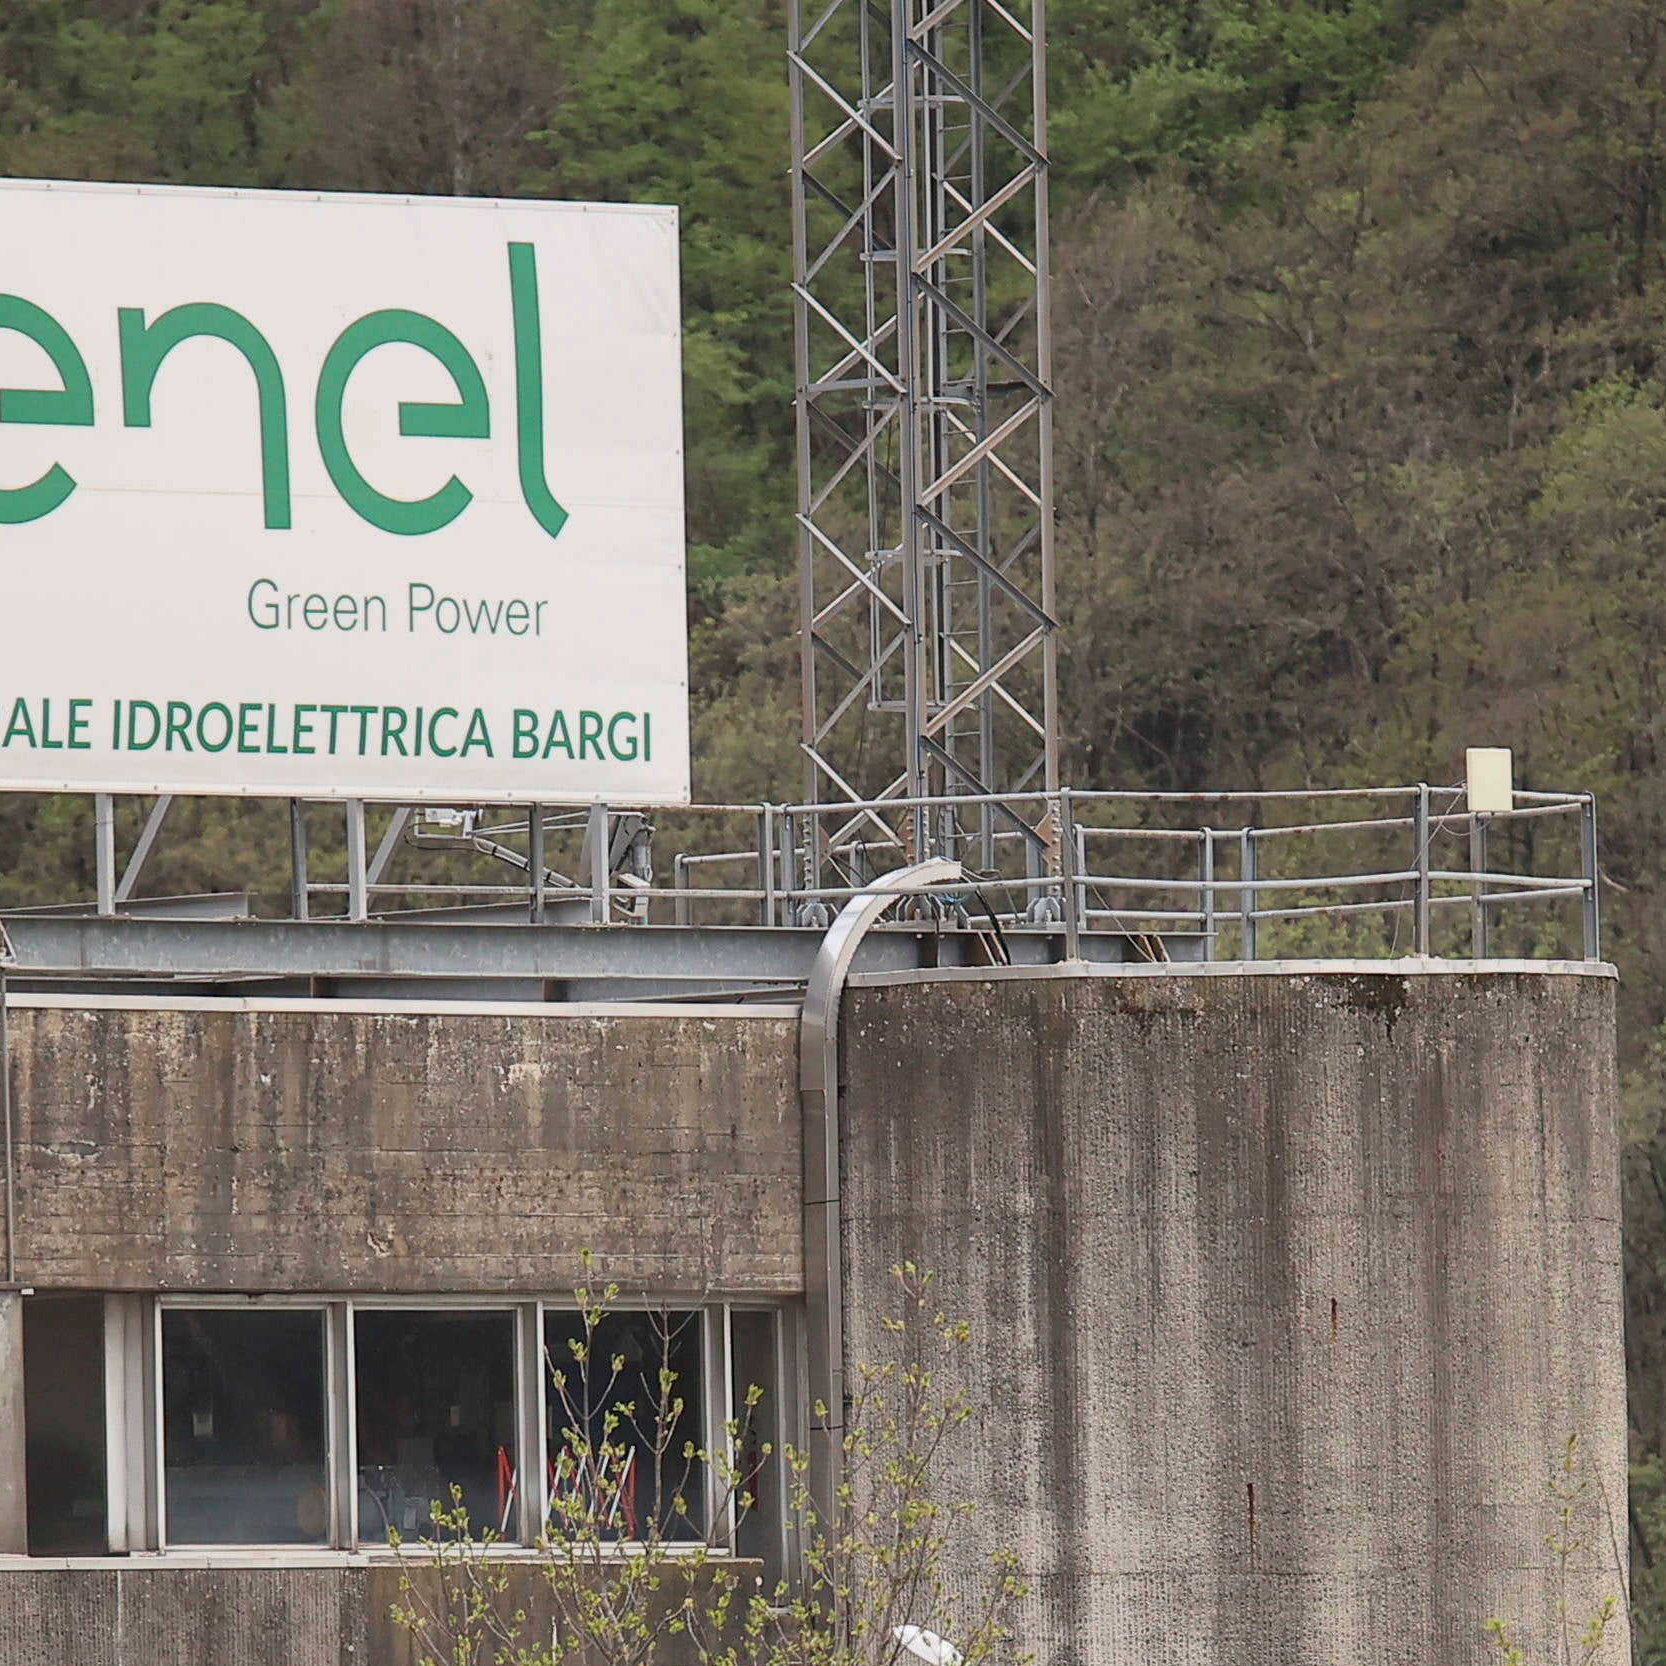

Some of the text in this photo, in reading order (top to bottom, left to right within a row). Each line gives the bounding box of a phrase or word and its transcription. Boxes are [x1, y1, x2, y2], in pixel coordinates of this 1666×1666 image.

[247, 578, 548, 636] Green Power
[112, 699, 494, 758] IDROELETTRICA
[511, 708, 652, 762] BARGI
